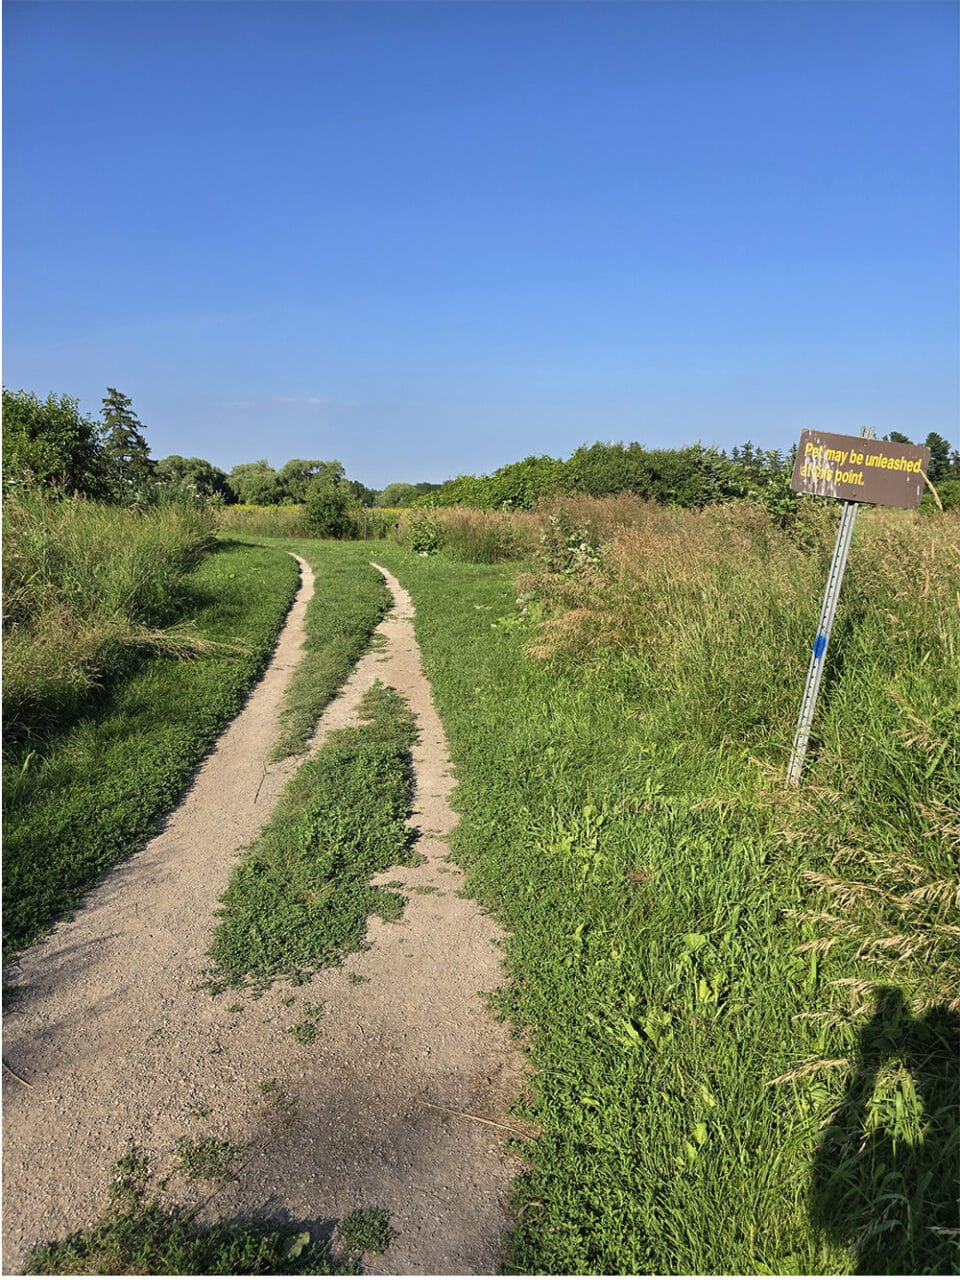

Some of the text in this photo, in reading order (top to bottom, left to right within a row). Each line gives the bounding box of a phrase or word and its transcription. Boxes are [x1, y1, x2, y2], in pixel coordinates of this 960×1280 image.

[805, 442, 922, 473] Pet may be unleashed
[800, 464, 811, 477] at
[834, 469, 864, 486] point.
